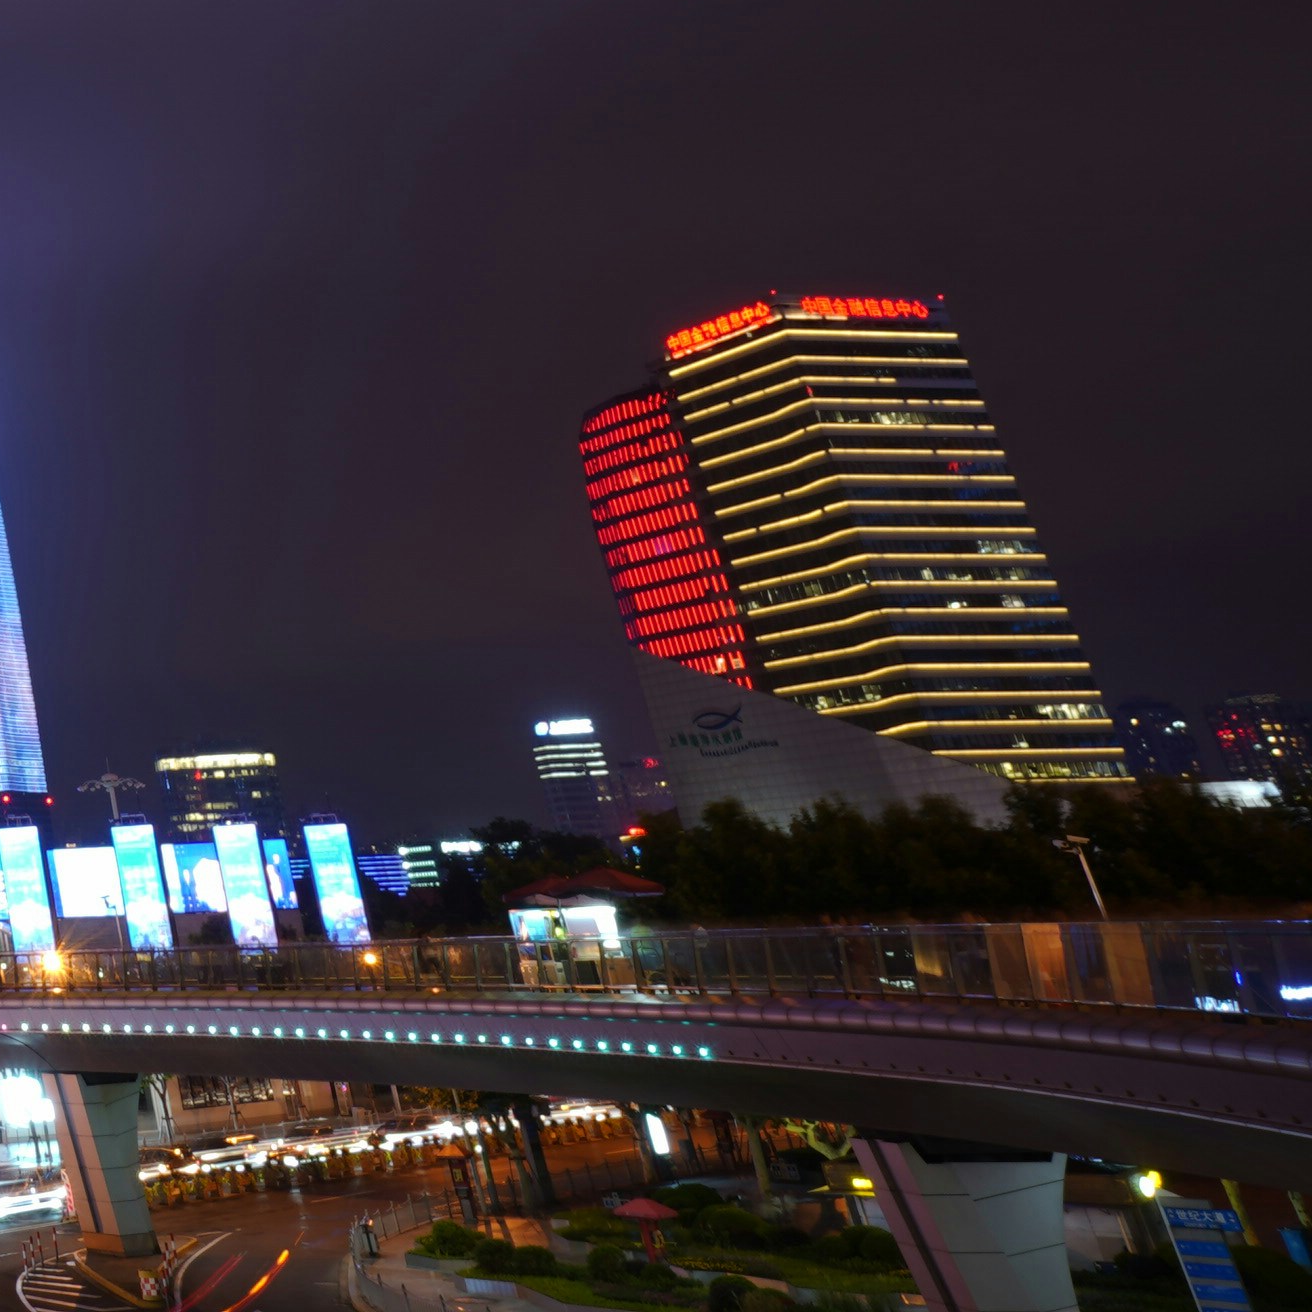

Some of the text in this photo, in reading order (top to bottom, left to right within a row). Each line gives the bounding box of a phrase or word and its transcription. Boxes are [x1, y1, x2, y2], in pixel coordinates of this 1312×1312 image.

[801, 294, 929, 319] 中国金融信息中心
[666, 301, 770, 351] 中国金融信息中心
